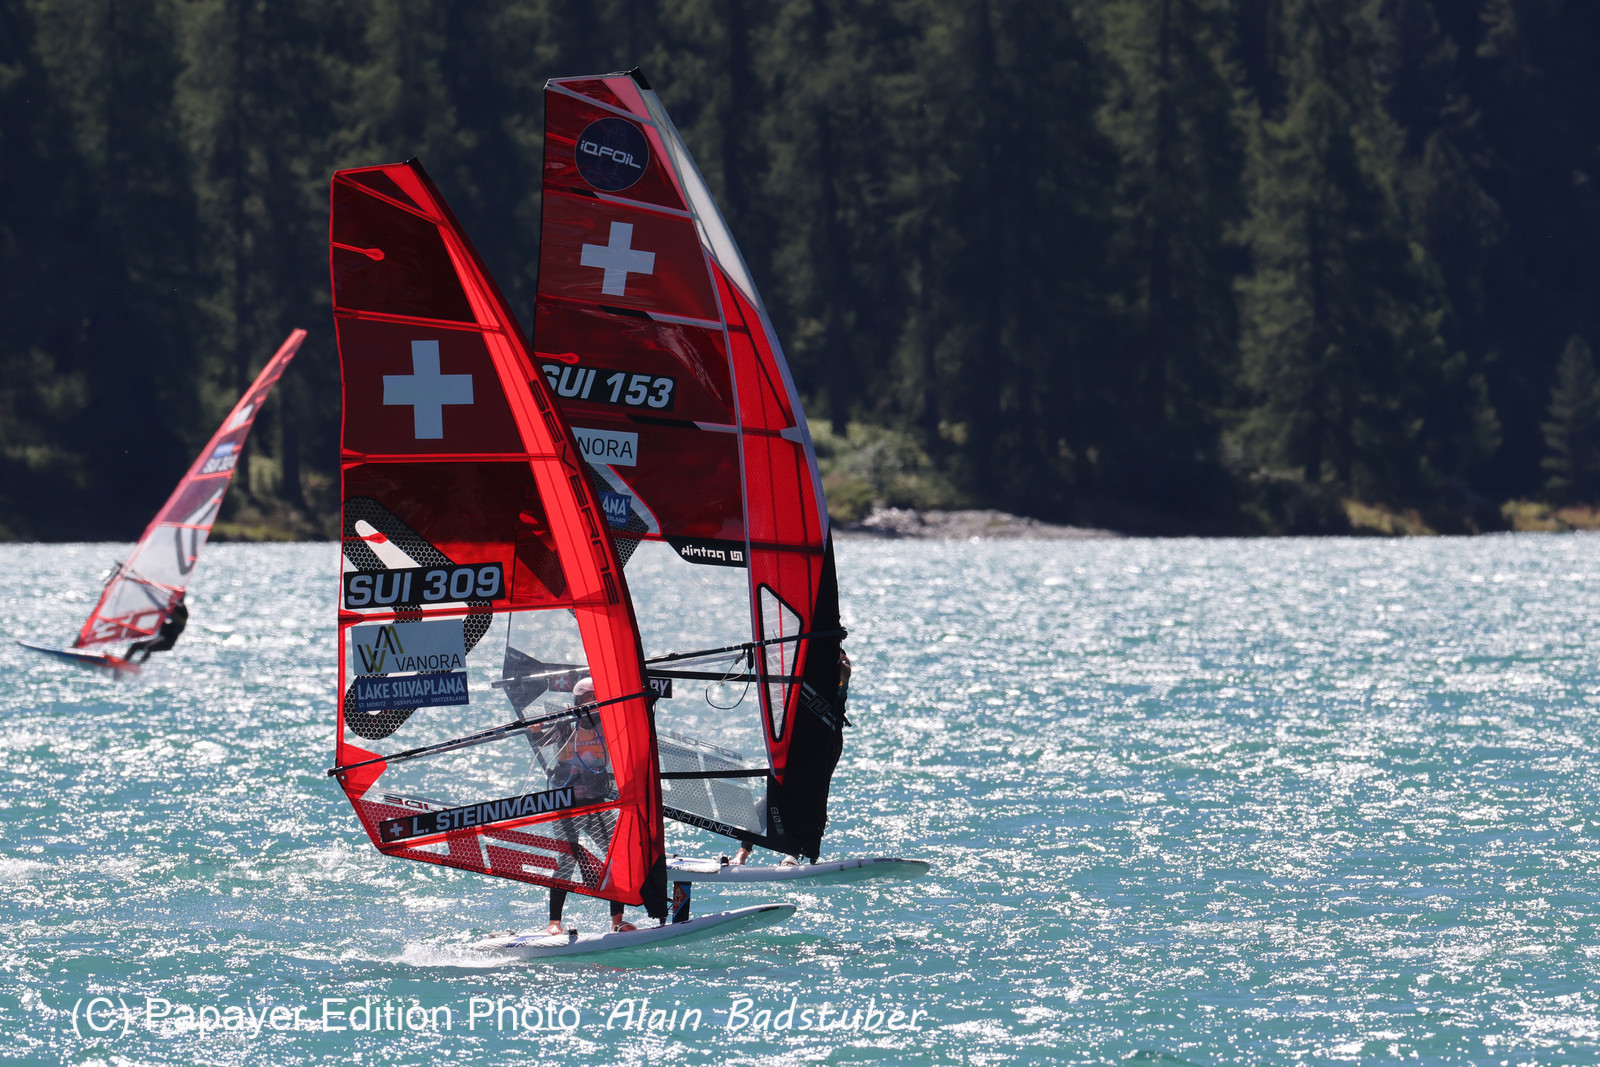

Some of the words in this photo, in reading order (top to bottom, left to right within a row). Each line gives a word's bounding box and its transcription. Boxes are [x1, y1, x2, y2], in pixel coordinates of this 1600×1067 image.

[541, 363, 597, 400] SUI
[606, 371, 674, 409] 153
[577, 436, 634, 459] NORA
[347, 571, 413, 606] SUI
[423, 565, 501, 601] 309
[394, 653, 462, 671] VANORA
[357, 682, 390, 701] LAKE
[391, 675, 466, 698] SILVAPLANA
[430, 695, 467, 703] SWITZERLAND
[412, 817, 430, 836] L.
[435, 787, 573, 831] STEINMANN
[663, 806, 738, 839] RNATIONAL
